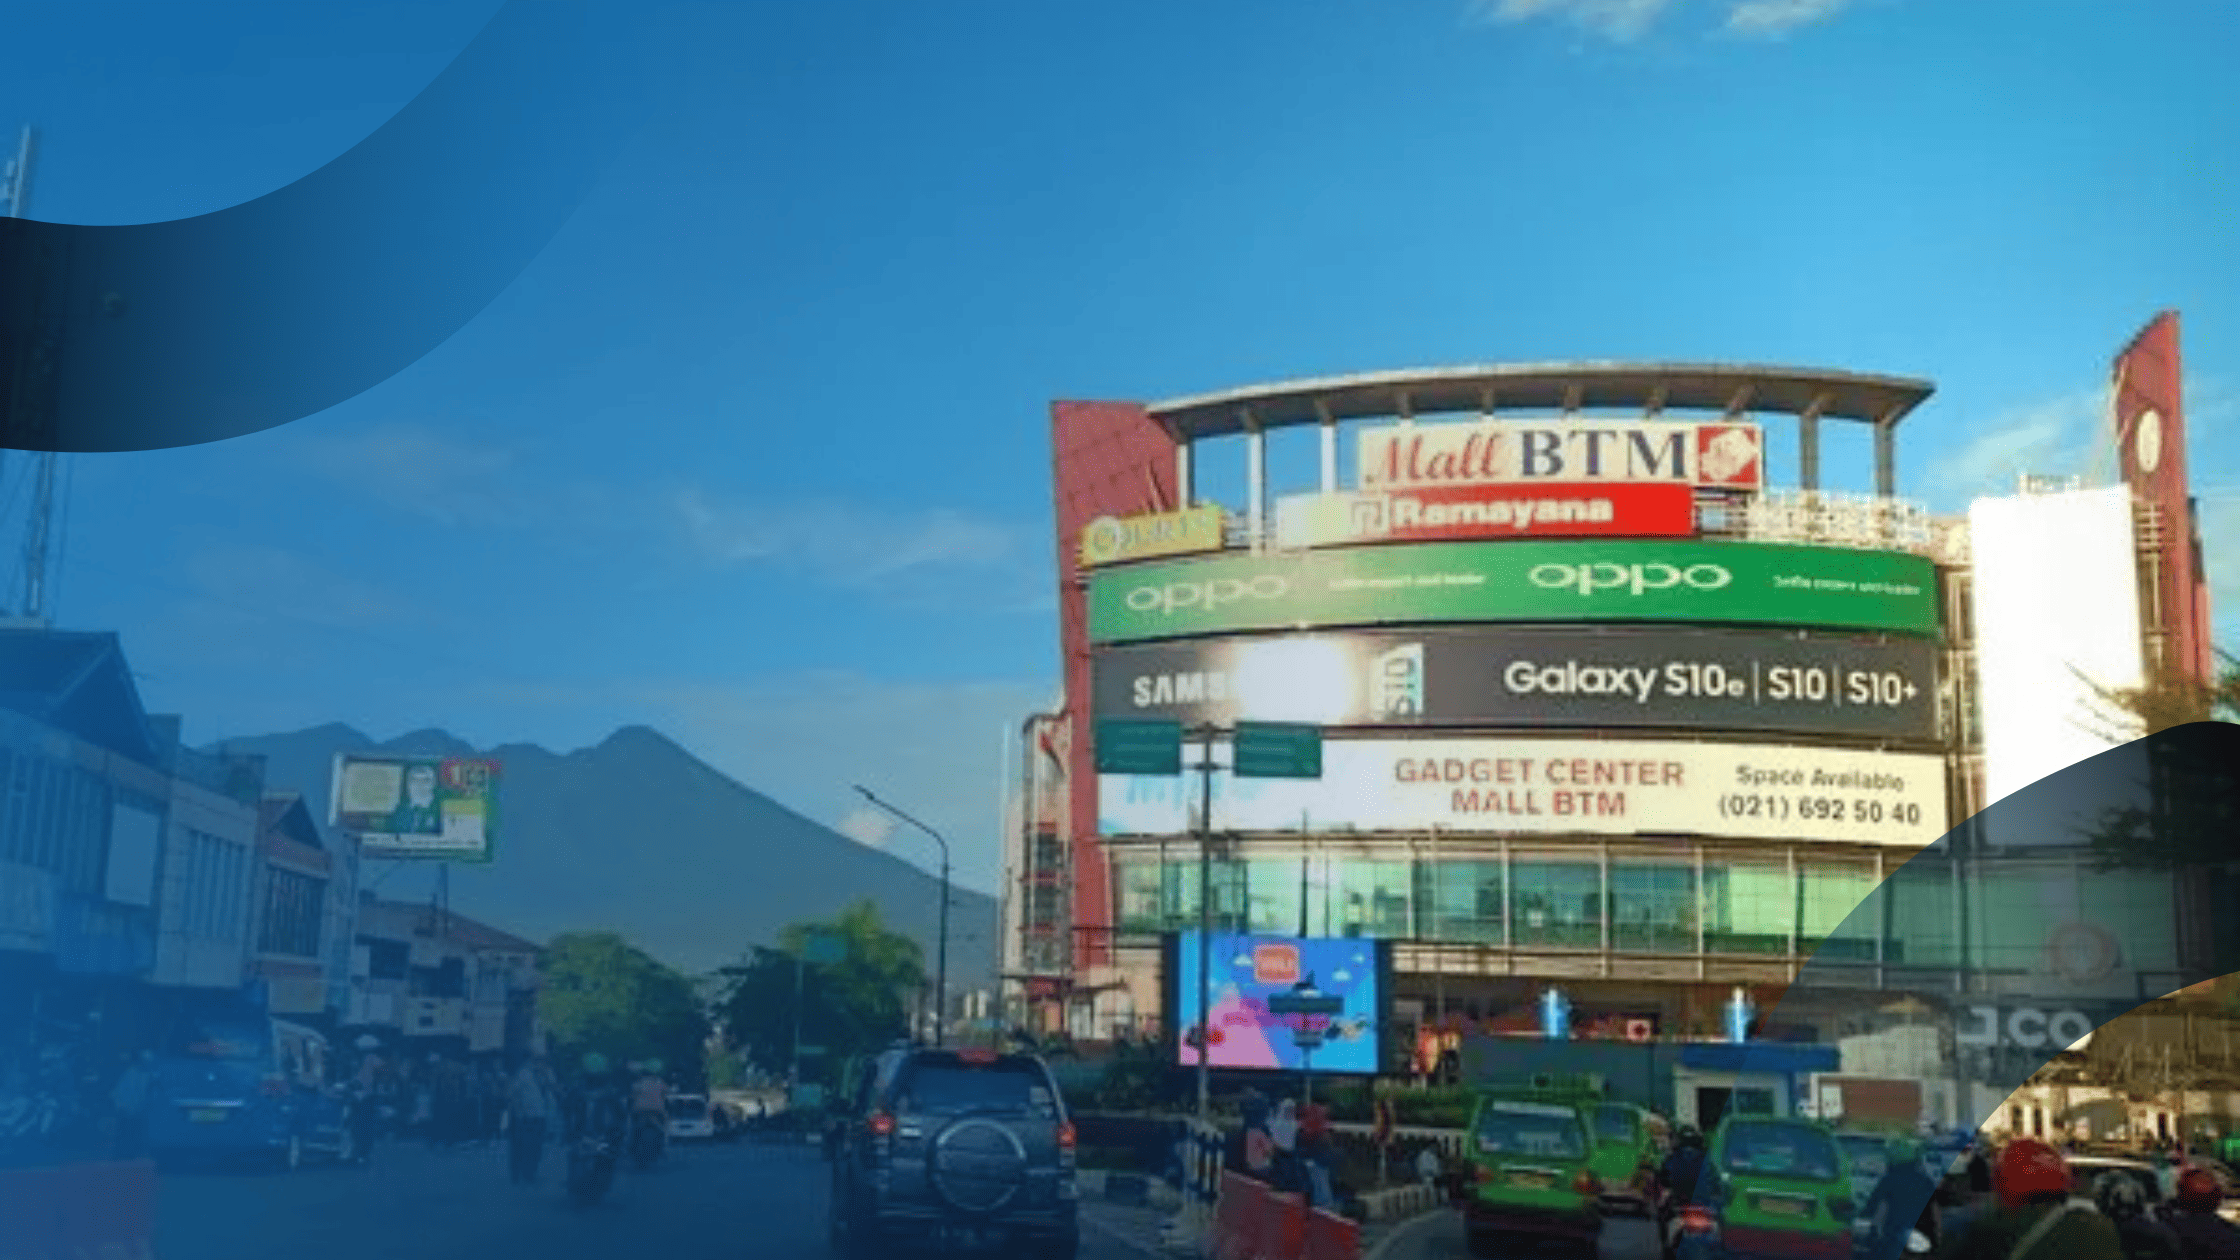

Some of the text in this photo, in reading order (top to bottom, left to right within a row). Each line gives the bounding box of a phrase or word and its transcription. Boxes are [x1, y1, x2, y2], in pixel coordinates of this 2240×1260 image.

[1366, 429, 1690, 482] Mall BTM
[1394, 498, 1615, 530] Ramayana
[1503, 660, 1919, 705] Galaxy S10e S10 S10+
[1394, 757, 1685, 786] GADGET CENTER
[1735, 764, 1905, 793] Space Available
[1450, 788, 1626, 817] MALL BTM
[1719, 794, 1920, 826] (021) 692 50 40
